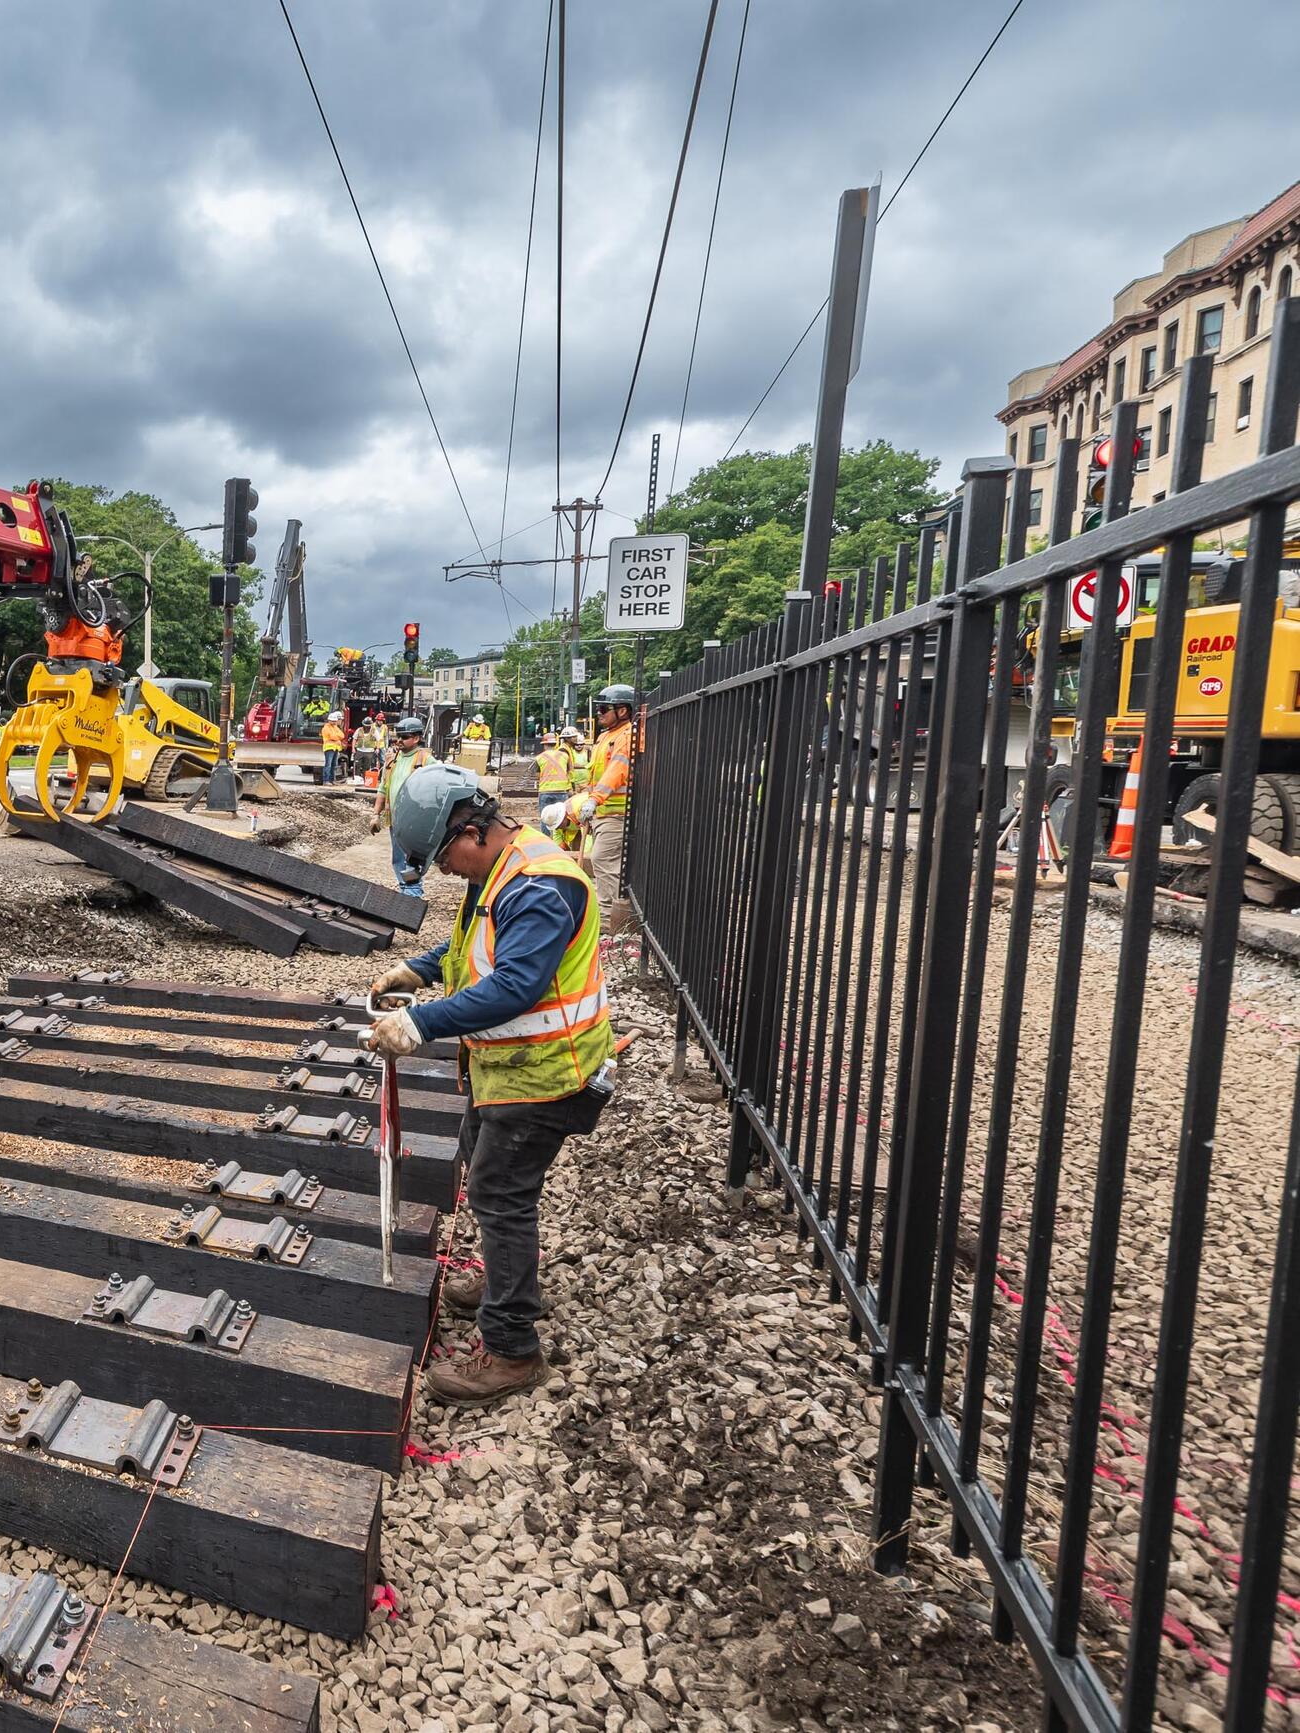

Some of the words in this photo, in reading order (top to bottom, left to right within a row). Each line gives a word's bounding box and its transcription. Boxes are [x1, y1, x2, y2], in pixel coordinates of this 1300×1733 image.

[621, 547, 675, 563] FIRST
[627, 566, 666, 581] CAR
[620, 584, 671, 599] STOP
[619, 602, 670, 616] HERE
[1187, 635, 1236, 654] GRAD
[1186, 653, 1222, 662] Railroad
[1200, 682, 1221, 692] SPS
